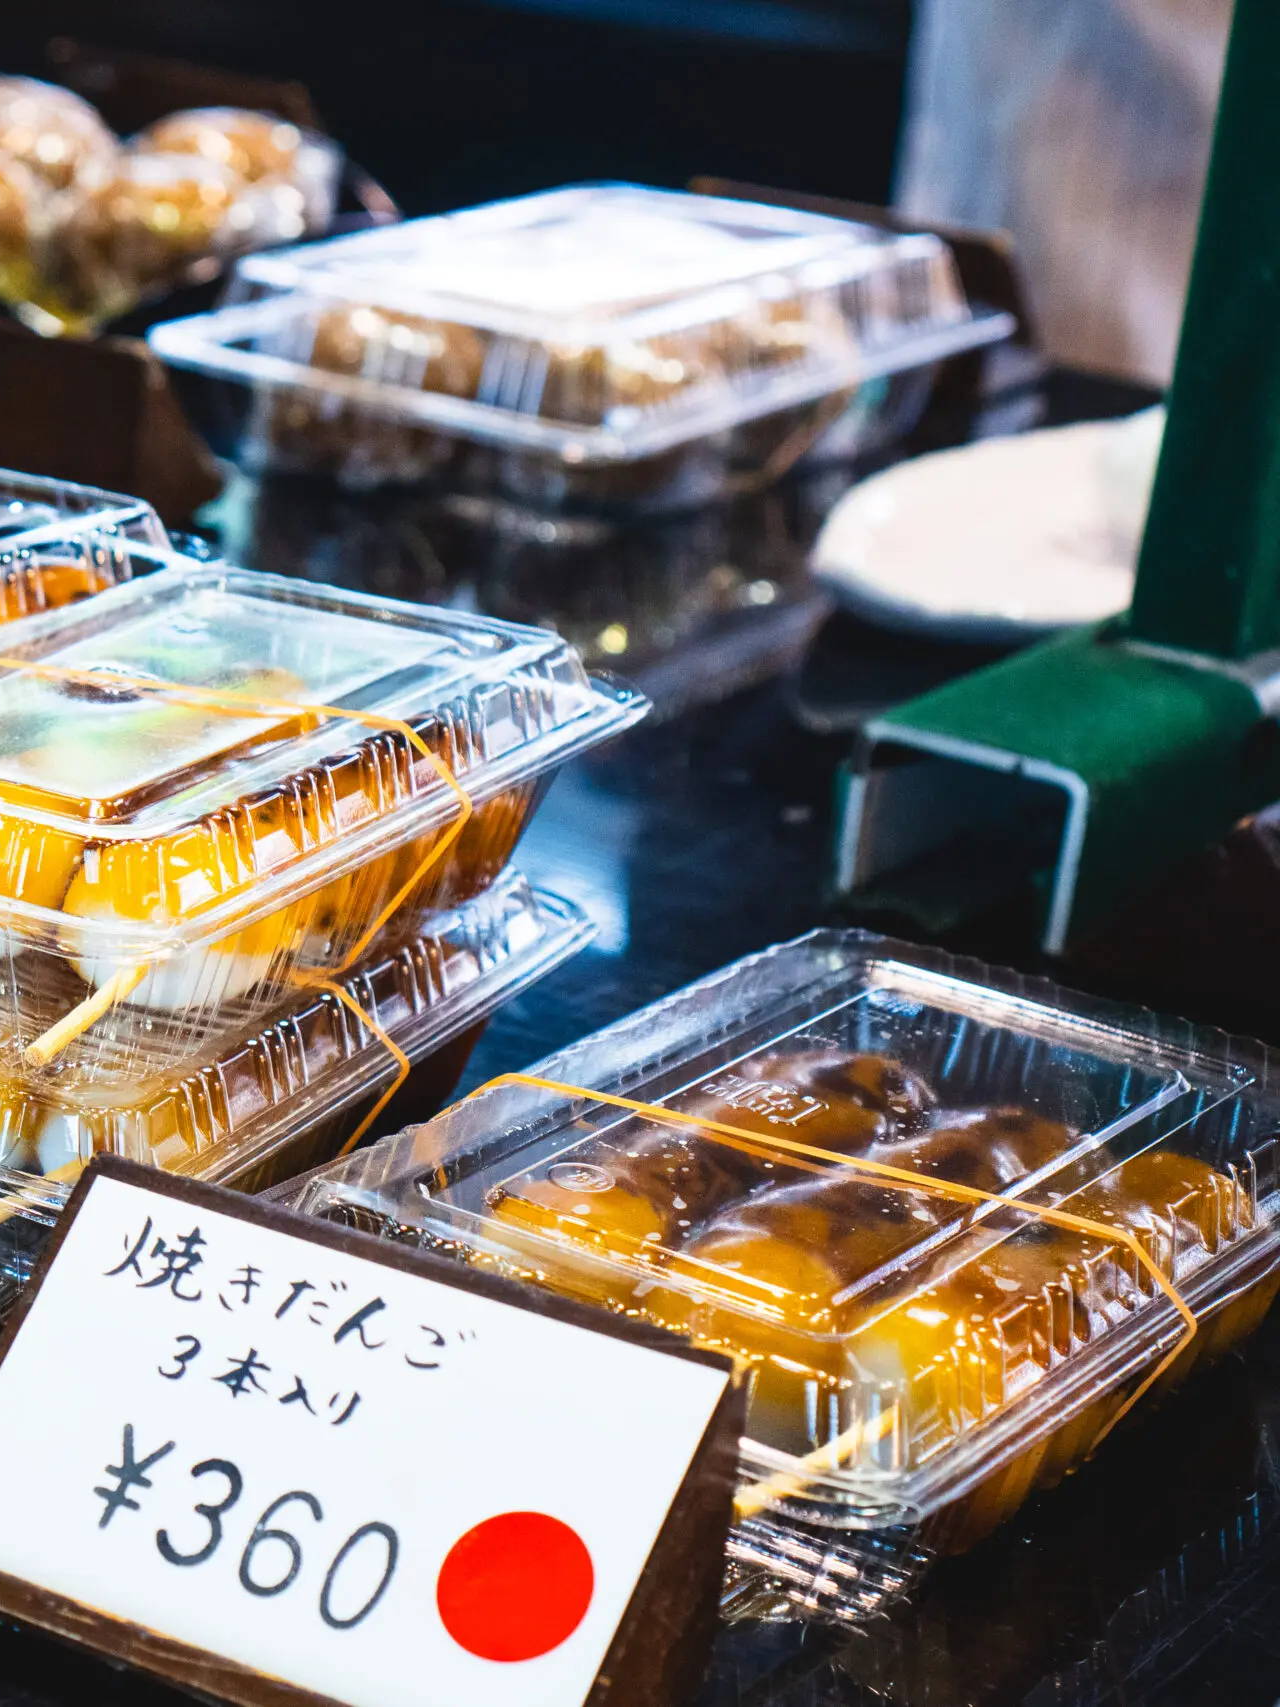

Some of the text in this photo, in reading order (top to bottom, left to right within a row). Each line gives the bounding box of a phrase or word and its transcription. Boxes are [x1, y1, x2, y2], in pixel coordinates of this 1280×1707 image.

[104, 1215, 477, 1369] 焼きだんご
[157, 1335, 362, 1426] 3本入り
[93, 1423, 400, 1630] ¥360
